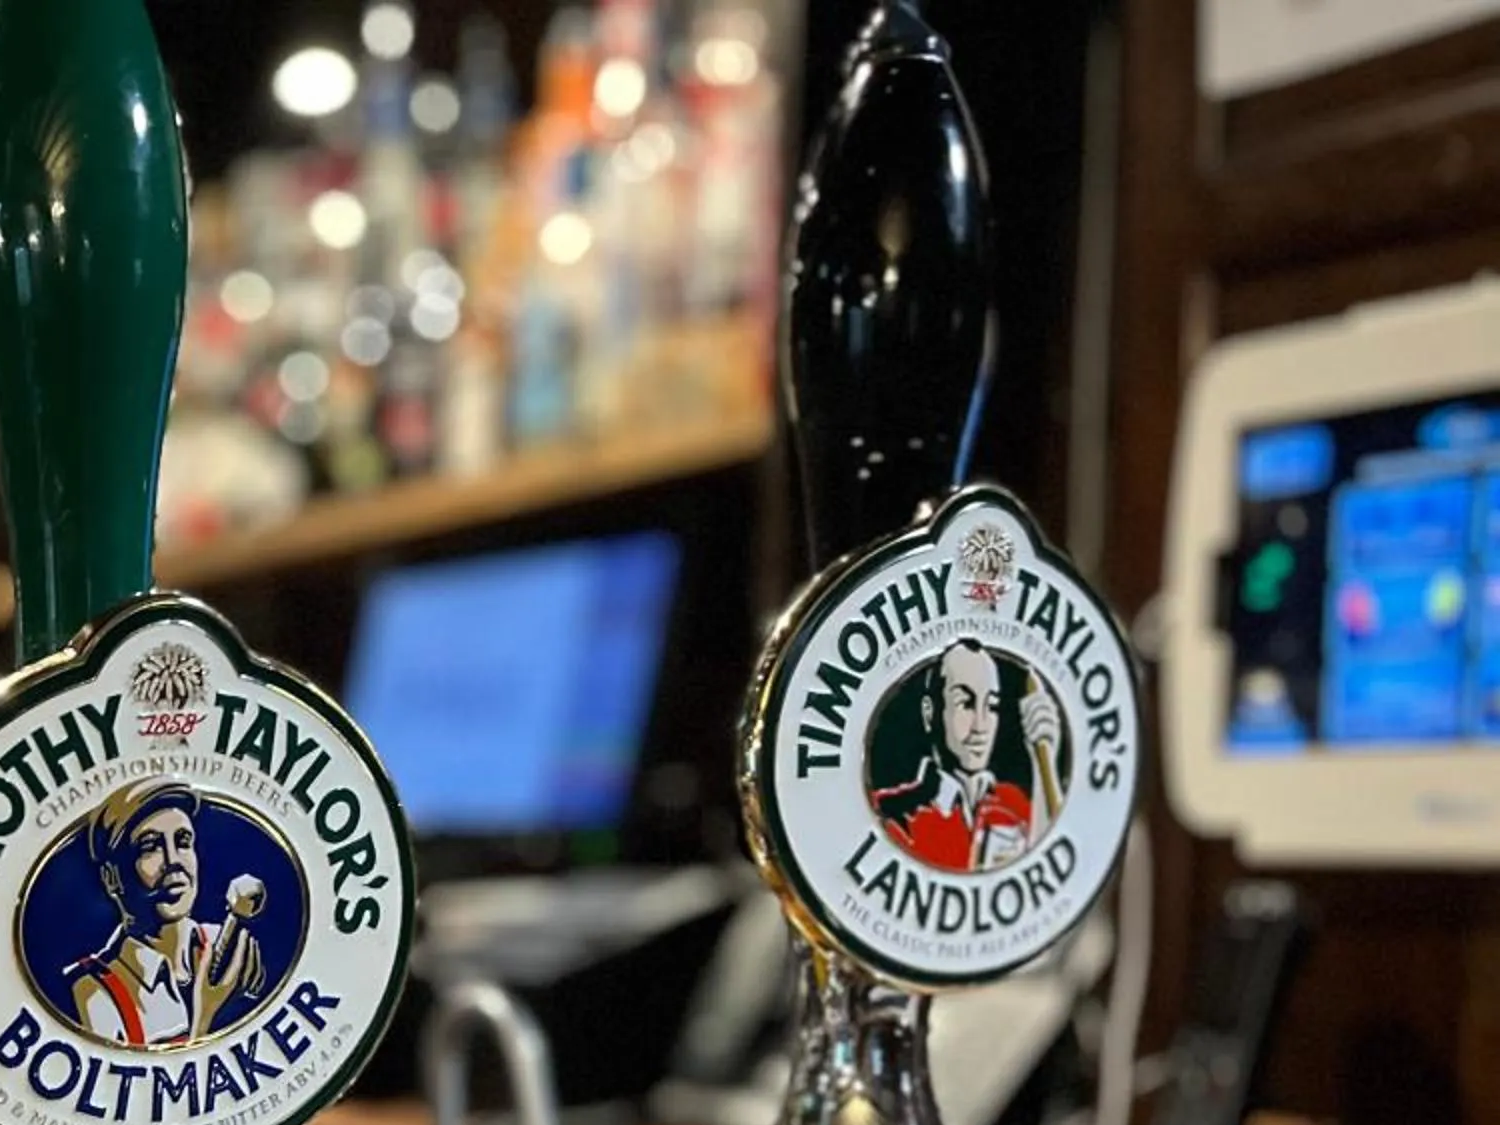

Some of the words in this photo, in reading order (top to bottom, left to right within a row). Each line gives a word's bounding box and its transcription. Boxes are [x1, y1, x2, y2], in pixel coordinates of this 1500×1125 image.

[797, 562, 953, 779] TIMOTHY
[1015, 568, 1130, 792] TAYLOR'S
[885, 617, 1022, 668] CHAMPIONSHIP
[137, 712, 208, 737] 1858
[35, 755, 224, 830] CHAMPIONSHIP
[231, 766, 293, 817] BEERS
[214, 692, 389, 936] TAYLOR'S
[844, 831, 1078, 936] LANDLORD
[11, 1102, 25, 1118] &
[286, 1059, 315, 1099] ABV
